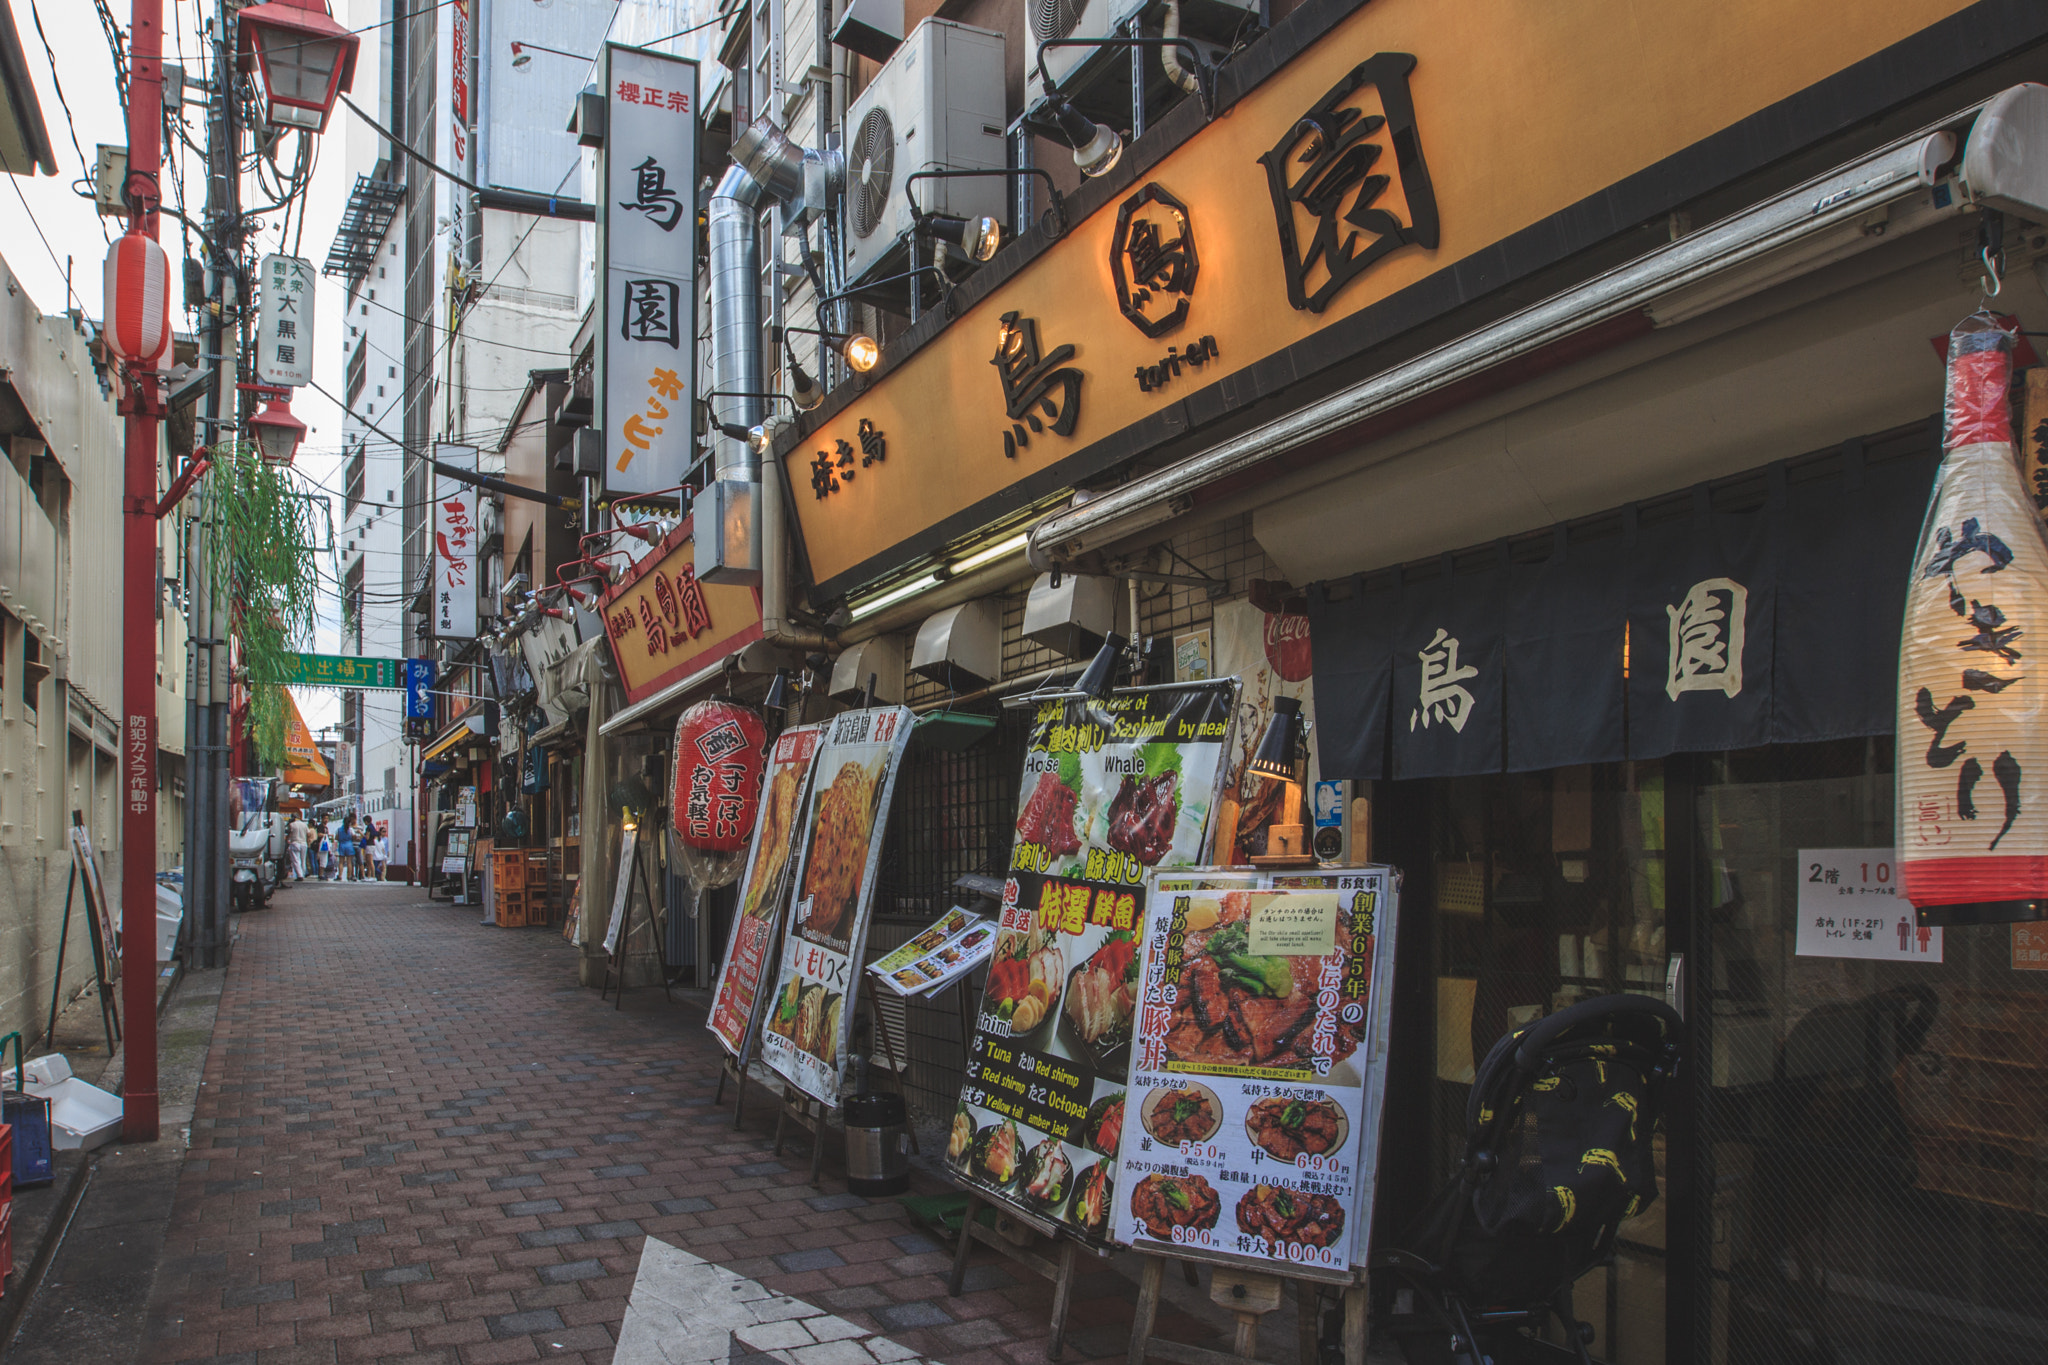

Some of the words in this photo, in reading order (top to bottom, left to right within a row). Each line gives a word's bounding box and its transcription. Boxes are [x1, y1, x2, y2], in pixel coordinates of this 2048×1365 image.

[616, 80, 689, 113] 櫻正宗
[619, 156, 683, 350] 鳥園
[276, 294, 297, 364] 大黒屋
[615, 366, 685, 473] ホッピー
[810, 418, 886, 500] 焼き鳥
[1135, 694, 1149, 711] of
[1110, 713, 1171, 738] Sashimi
[1178, 718, 1195, 739] by
[129, 715, 148, 815] 防犯カメラ作動中
[1105, 756, 1145, 774] Whale
[686, 764, 715, 837] お気軽に
[1085, 846, 1143, 884] 鯨刺し
[1808, 863, 1840, 884] 2階
[1815, 917, 1835, 928] 店内
[1825, 930, 1845, 938] トイレ
[1163, 898, 1189, 1001] 厚めの豚肉を
[1343, 892, 1374, 1022] 創業65年の
[1139, 917, 1169, 1071] 焼き上げた豚丼
[987, 1041, 1012, 1063] Tuna
[1035, 1060, 1052, 1077] Red
[982, 1067, 1001, 1085] Red
[1028, 1083, 1047, 1104] たこ
[1048, 1090, 1088, 1119] Octopas
[1134, 1076, 1188, 1090] 気持ち少なめ
[1241, 1083, 1325, 1101] 気持ち多めで標準
[985, 1094, 1010, 1113] Yellow
[1011, 1103, 1024, 1120] tail
[1028, 1113, 1051, 1130] amber
[1050, 1120, 1069, 1138] jack
[1140, 1137, 1152, 1152] 並
[1251, 1149, 1265, 1166] 中
[1125, 1159, 1189, 1178] かなりの満腹感
[1132, 1220, 1145, 1237] 大
[1237, 1236, 1268, 1256] 特大
